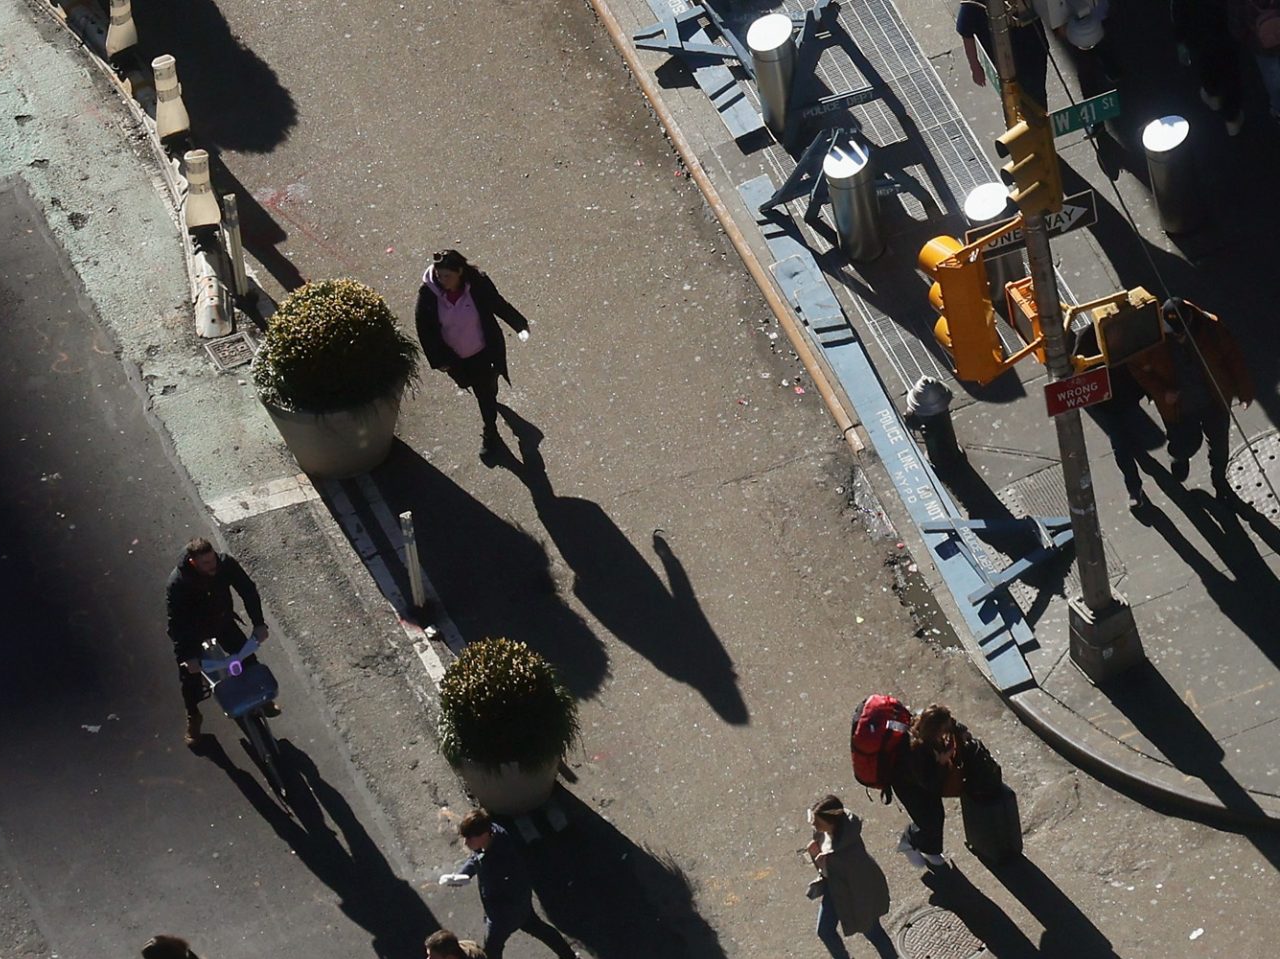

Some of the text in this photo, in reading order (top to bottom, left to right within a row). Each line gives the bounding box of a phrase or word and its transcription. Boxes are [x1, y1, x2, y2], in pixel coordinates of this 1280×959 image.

[802, 92, 874, 118] POLICE DEPT
[1055, 96, 1115, 132] W 41 St
[1056, 382, 1099, 402] WRONG
[1066, 392, 1092, 408] WAY
[876, 408, 904, 445] POLICE
[897, 450, 919, 473] LINE
[924, 500, 946, 521] NOT
[895, 471, 918, 504] NYPD
[960, 526, 998, 575] POLICE DEPT
